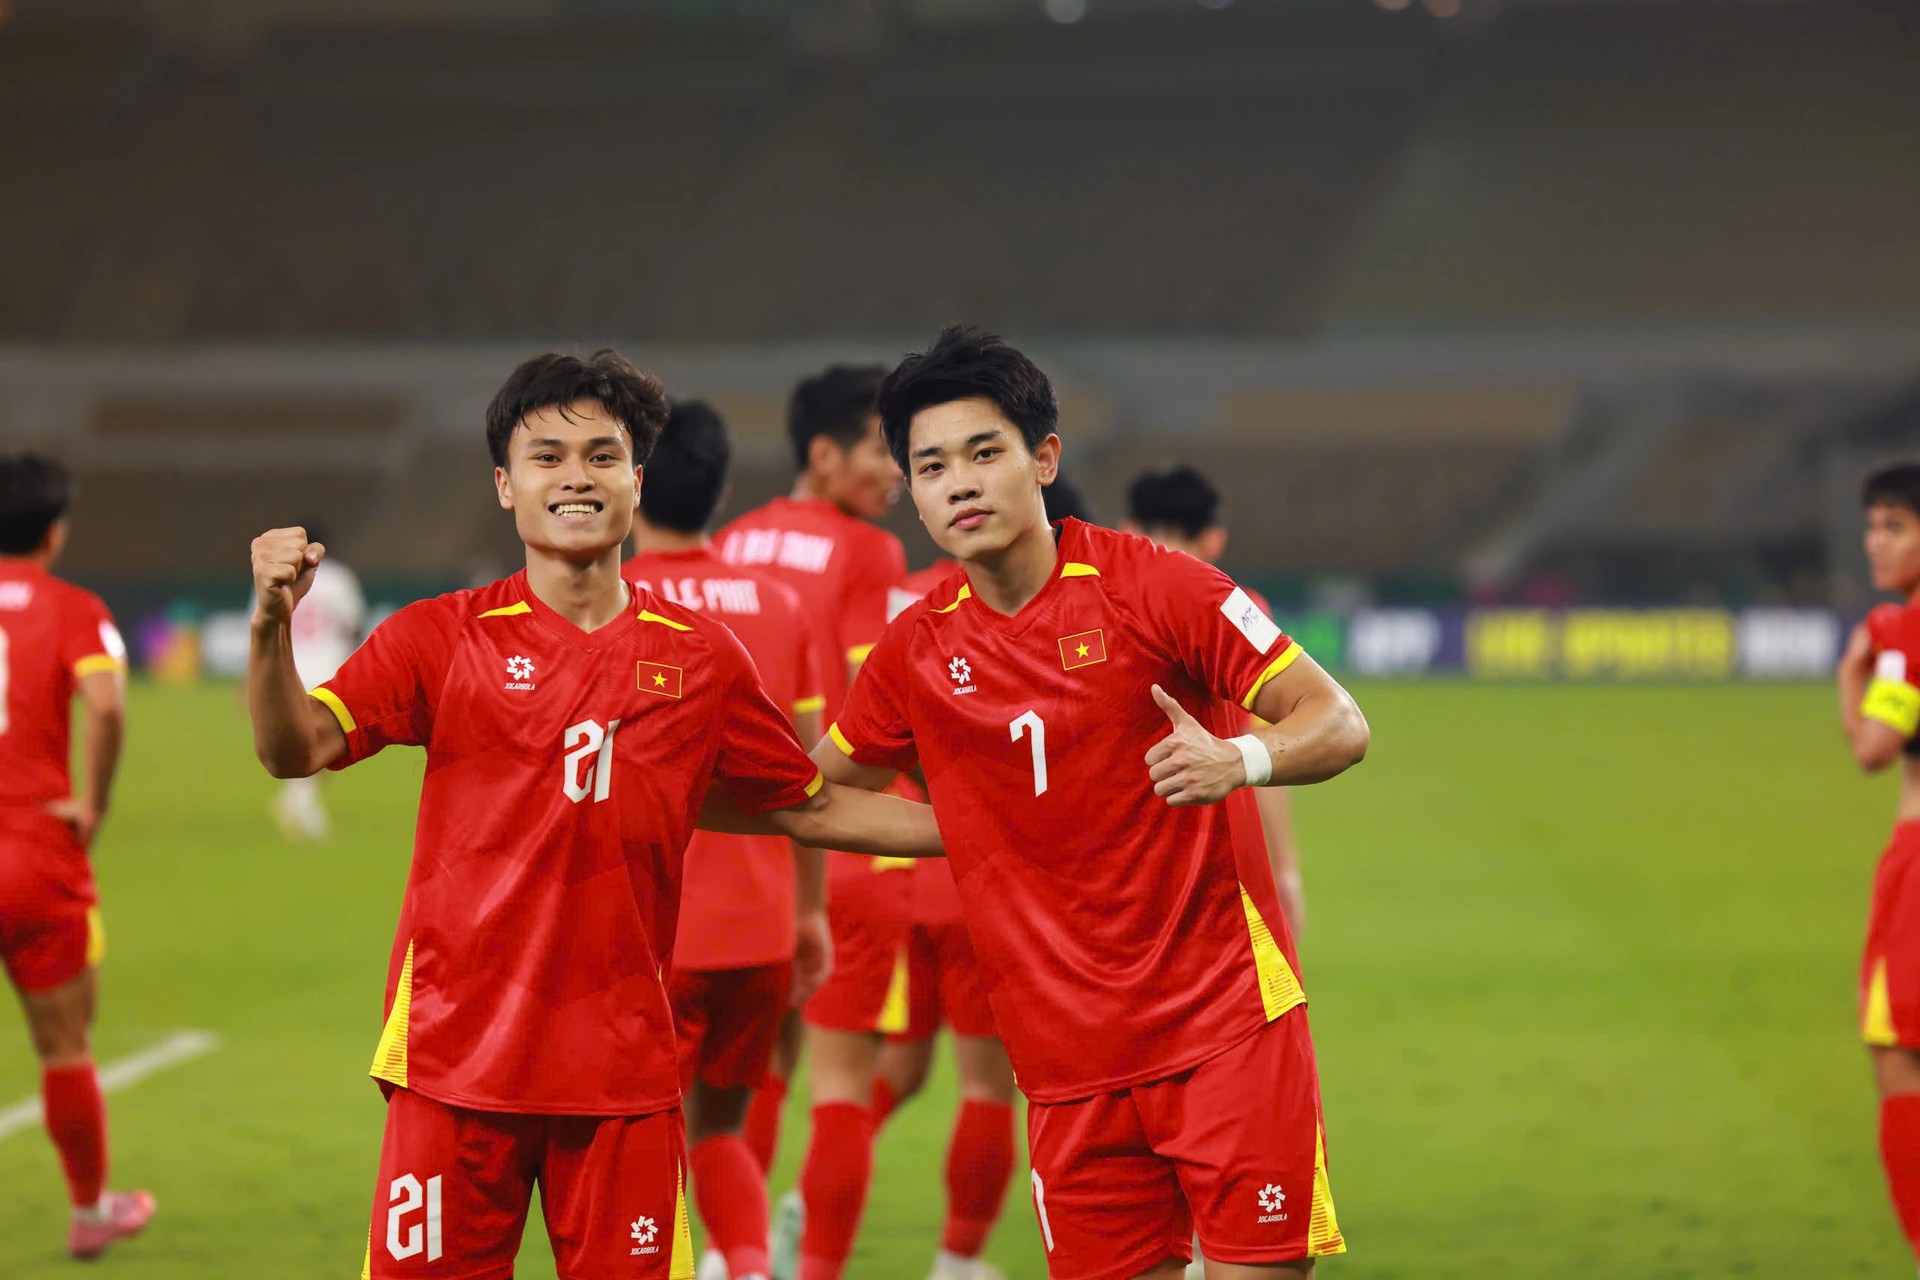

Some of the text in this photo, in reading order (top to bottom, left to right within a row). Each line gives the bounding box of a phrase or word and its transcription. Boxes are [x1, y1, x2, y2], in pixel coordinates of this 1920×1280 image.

[562, 718, 622, 804] 21
[1009, 709, 1048, 798] 7
[386, 1172, 443, 1263] 21
[1256, 1212, 1288, 1224] JOGARBOLA
